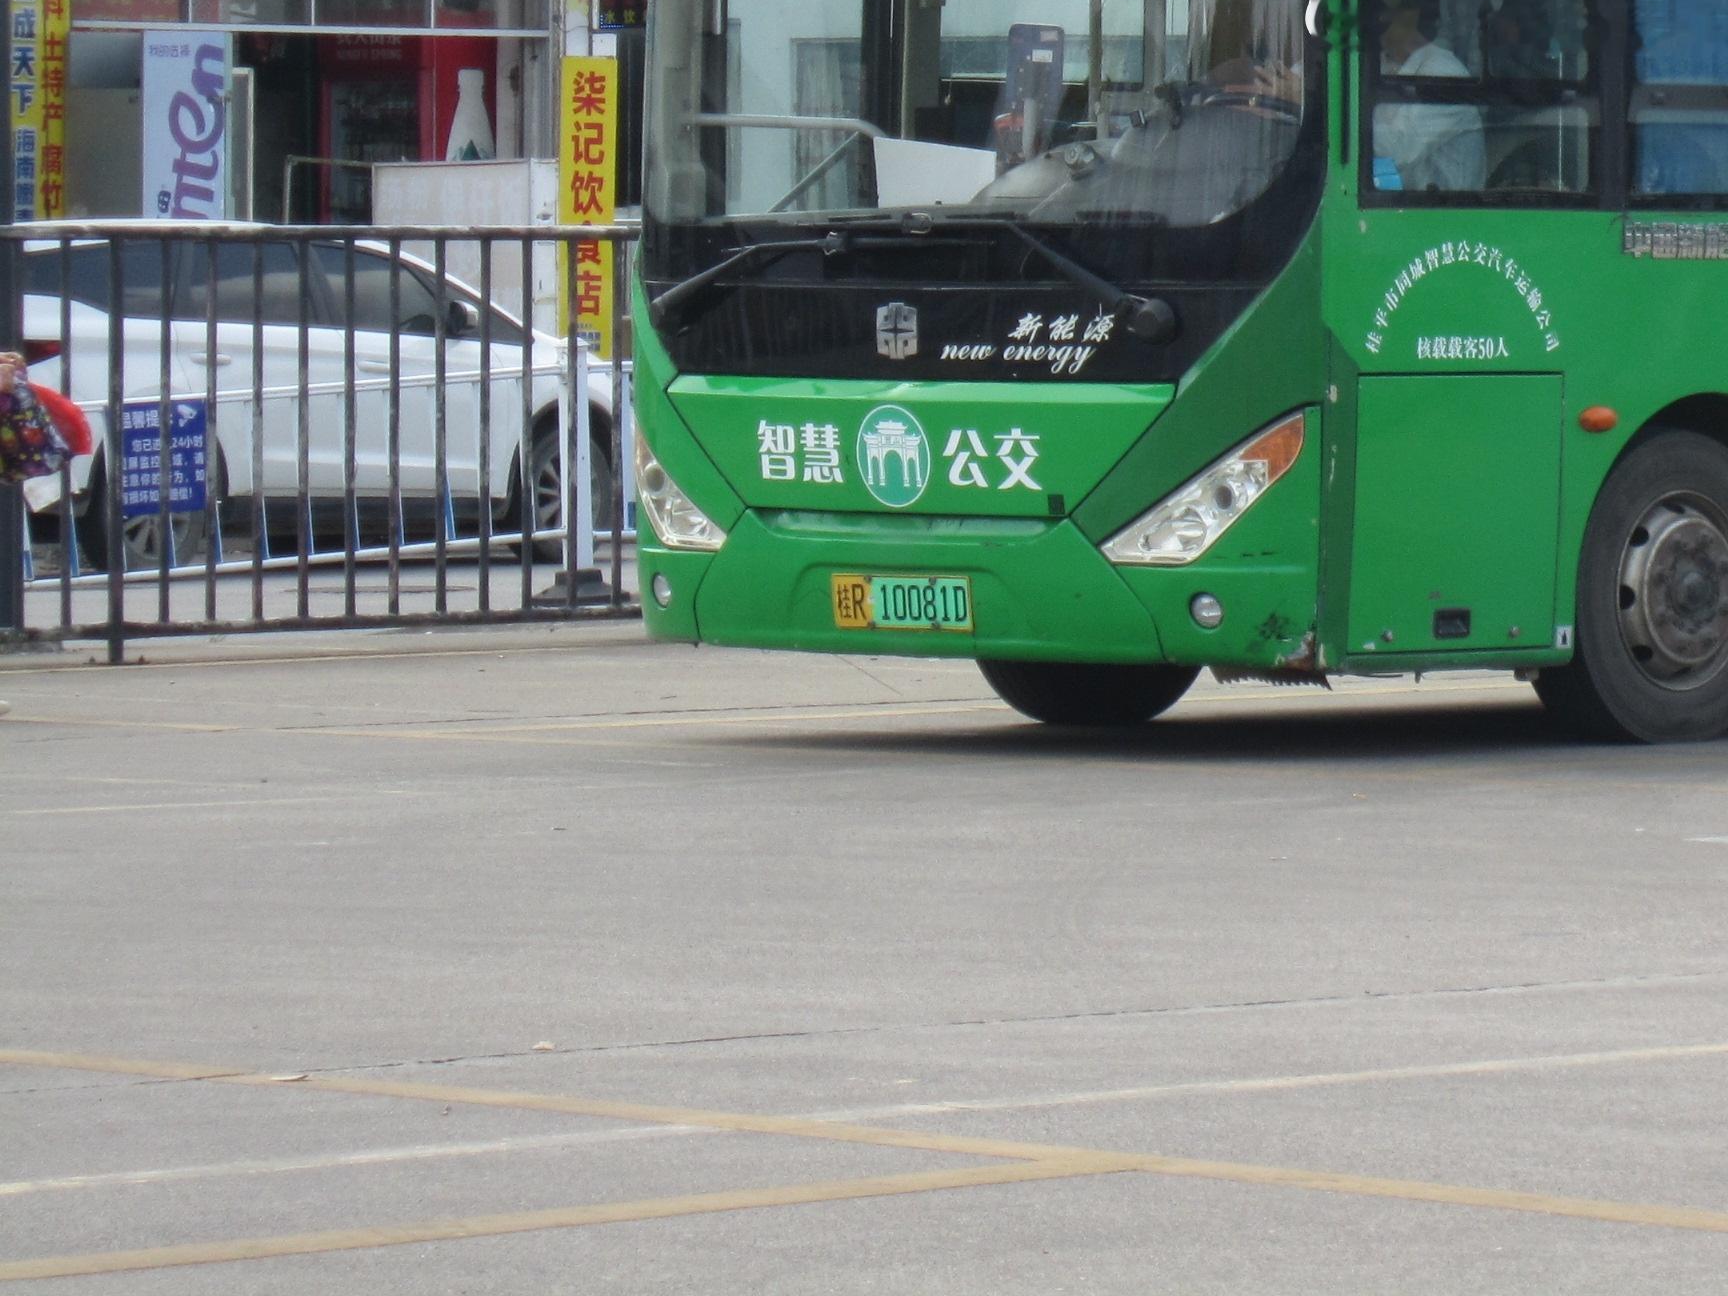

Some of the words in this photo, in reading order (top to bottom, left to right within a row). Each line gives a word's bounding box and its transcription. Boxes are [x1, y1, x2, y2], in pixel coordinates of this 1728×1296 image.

[1365, 240, 1560, 354] 桂平市同城智慧公交汽车运输公司
[1008, 312, 1115, 343] 新能源
[940, 344, 997, 361] new
[1003, 344, 1097, 375] energy
[1417, 336, 1509, 359] 核载载客50人
[757, 419, 844, 484] 智慧
[942, 427, 1042, 490] 公交
[837, 584, 866, 619] 桂R
[881, 584, 967, 621] 10081D
